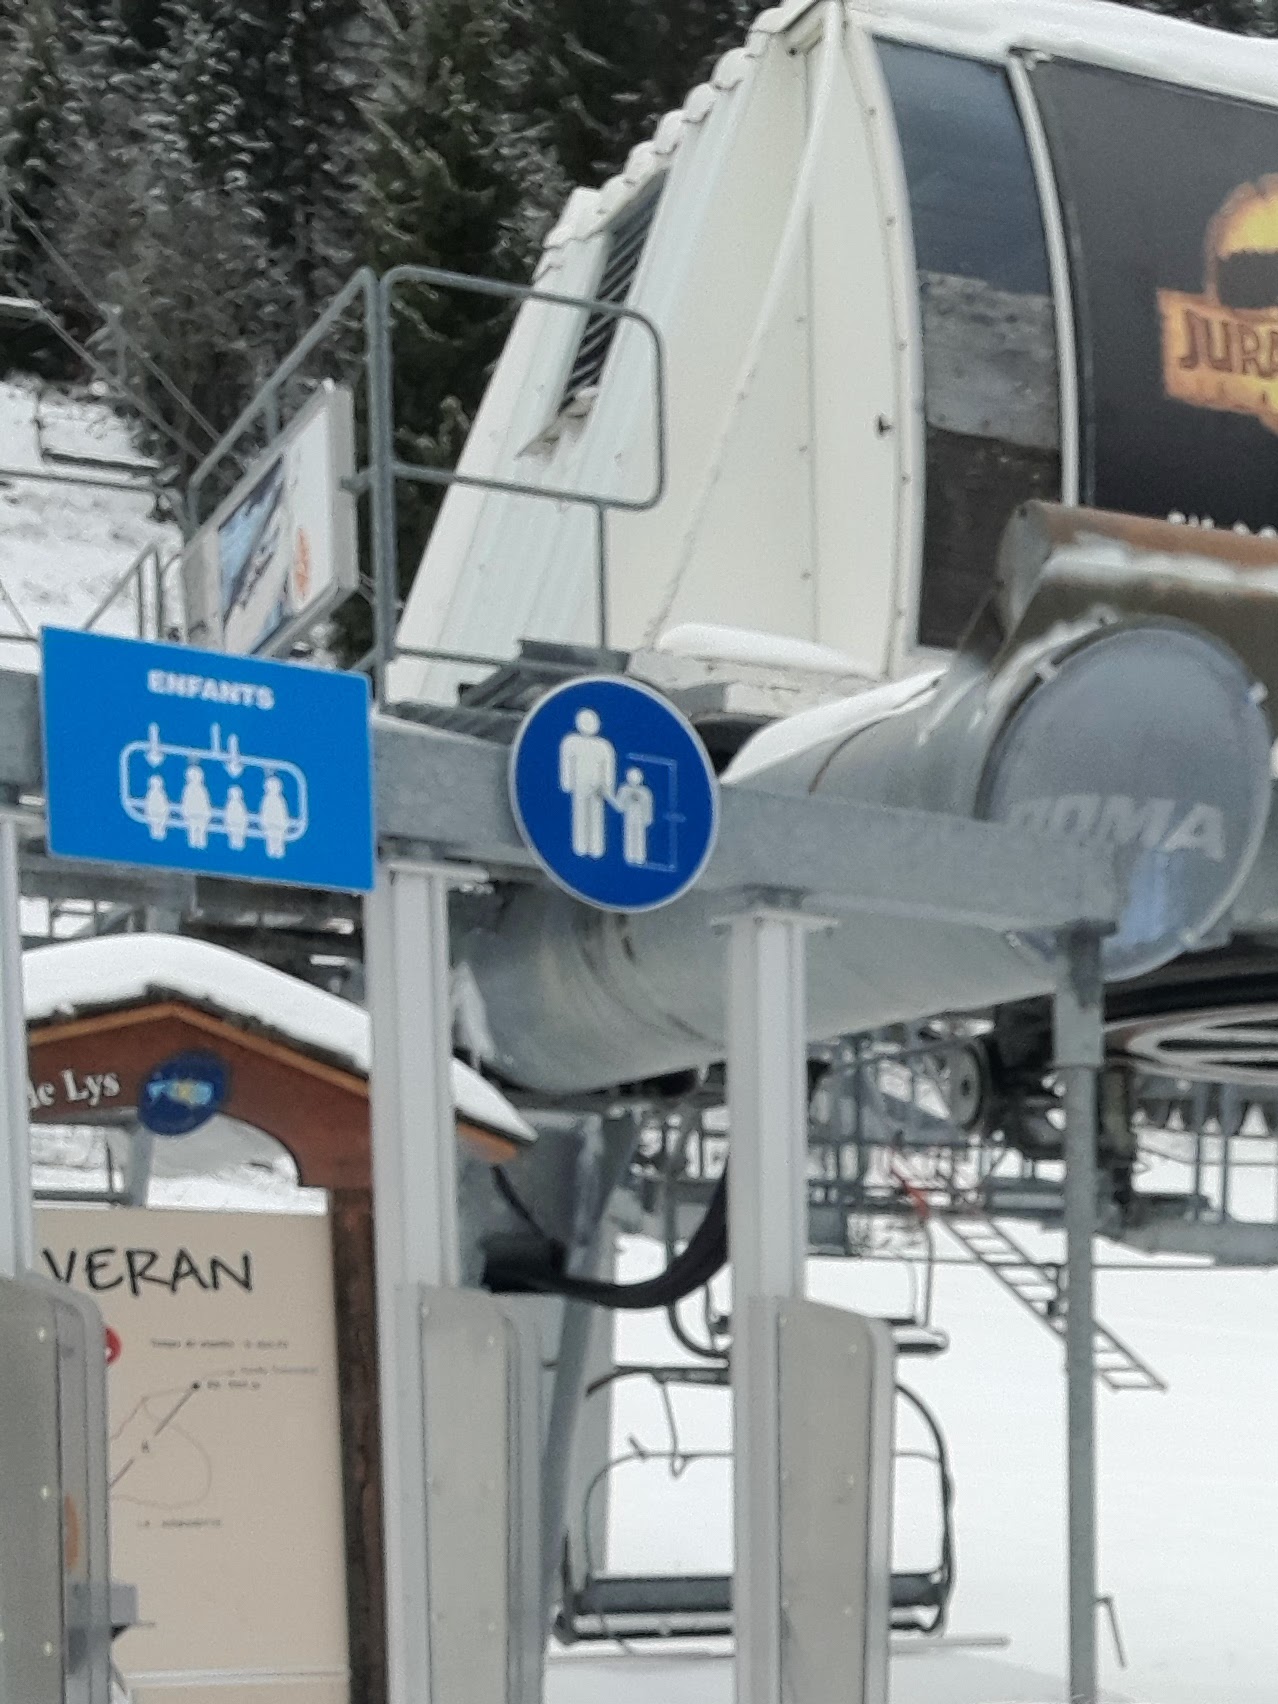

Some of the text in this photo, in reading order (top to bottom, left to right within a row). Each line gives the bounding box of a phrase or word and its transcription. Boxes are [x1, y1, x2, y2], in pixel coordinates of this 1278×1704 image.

[147, 669, 275, 710] ENFANTS
[61, 1068, 121, 1107] Lys
[41, 1247, 253, 1296] VERAN
